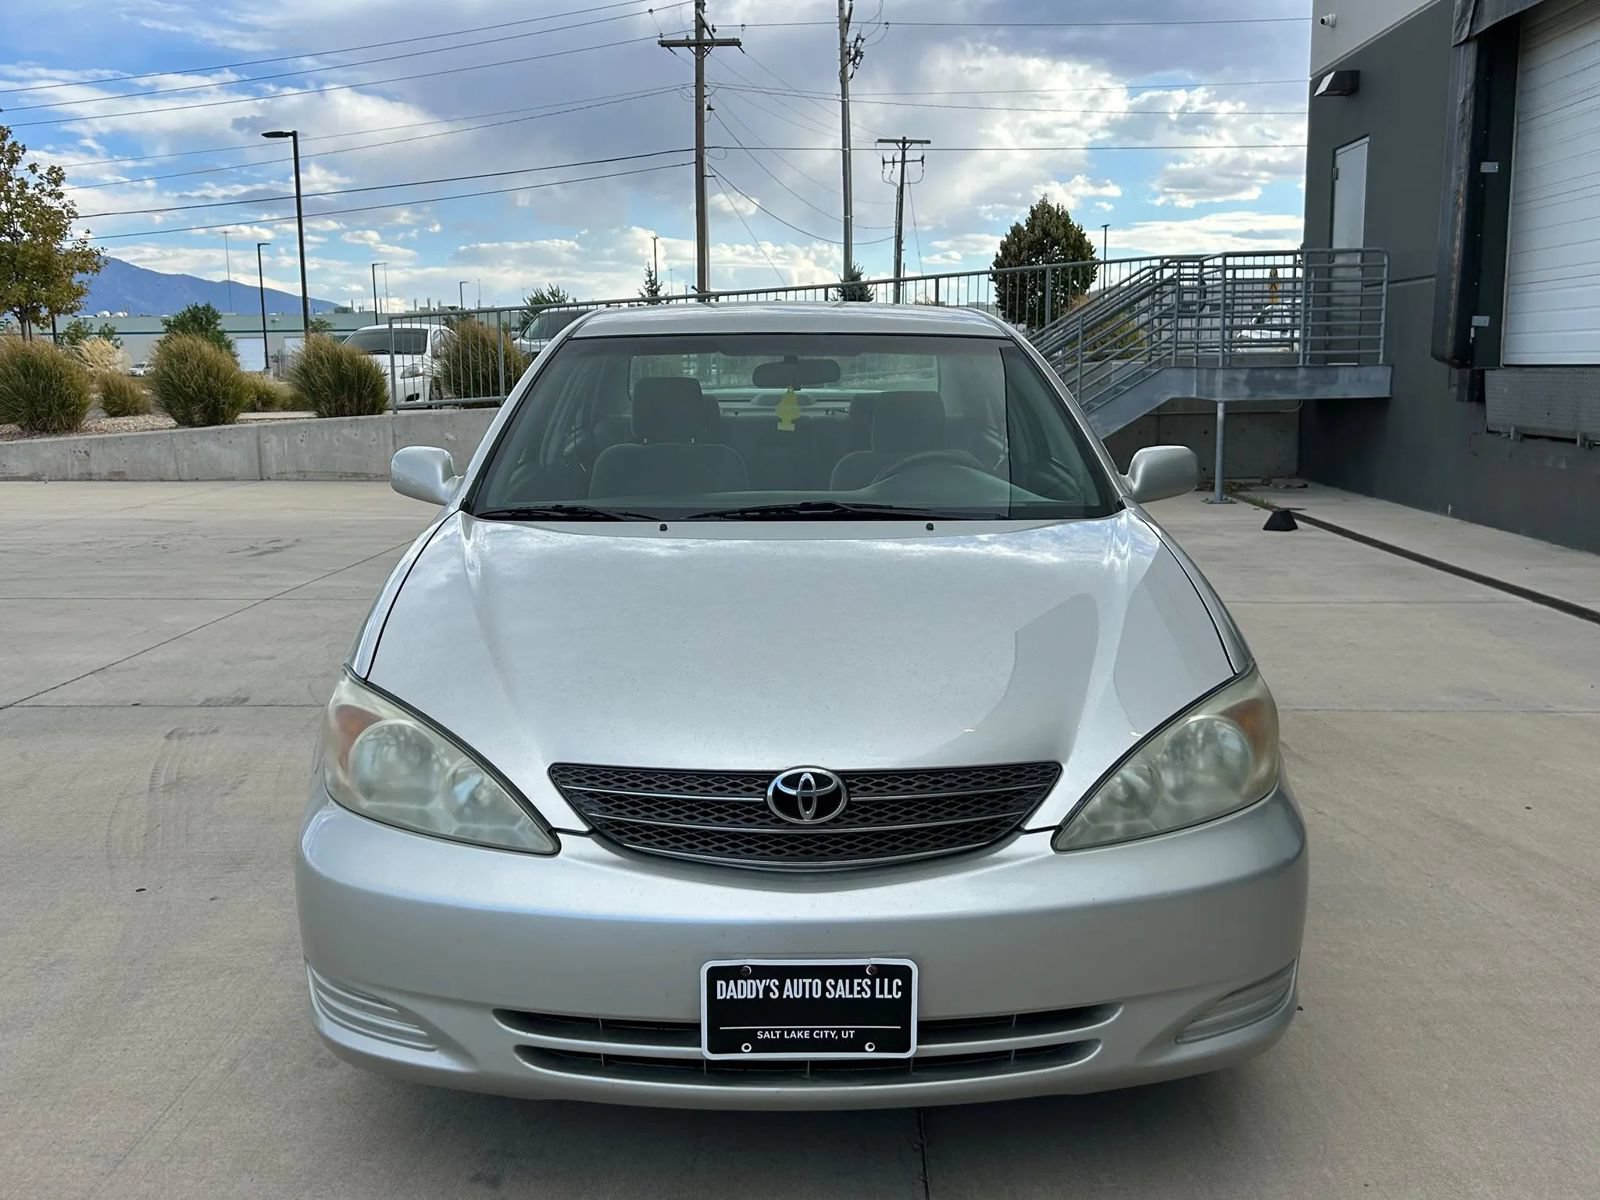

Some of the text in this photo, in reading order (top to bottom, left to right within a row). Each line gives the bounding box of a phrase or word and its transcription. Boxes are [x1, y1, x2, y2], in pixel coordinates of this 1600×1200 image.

[716, 978, 902, 1000] DADDY'S AUTO SALES LLC
[757, 1030, 855, 1040] SALT LAKE CITY, UT
